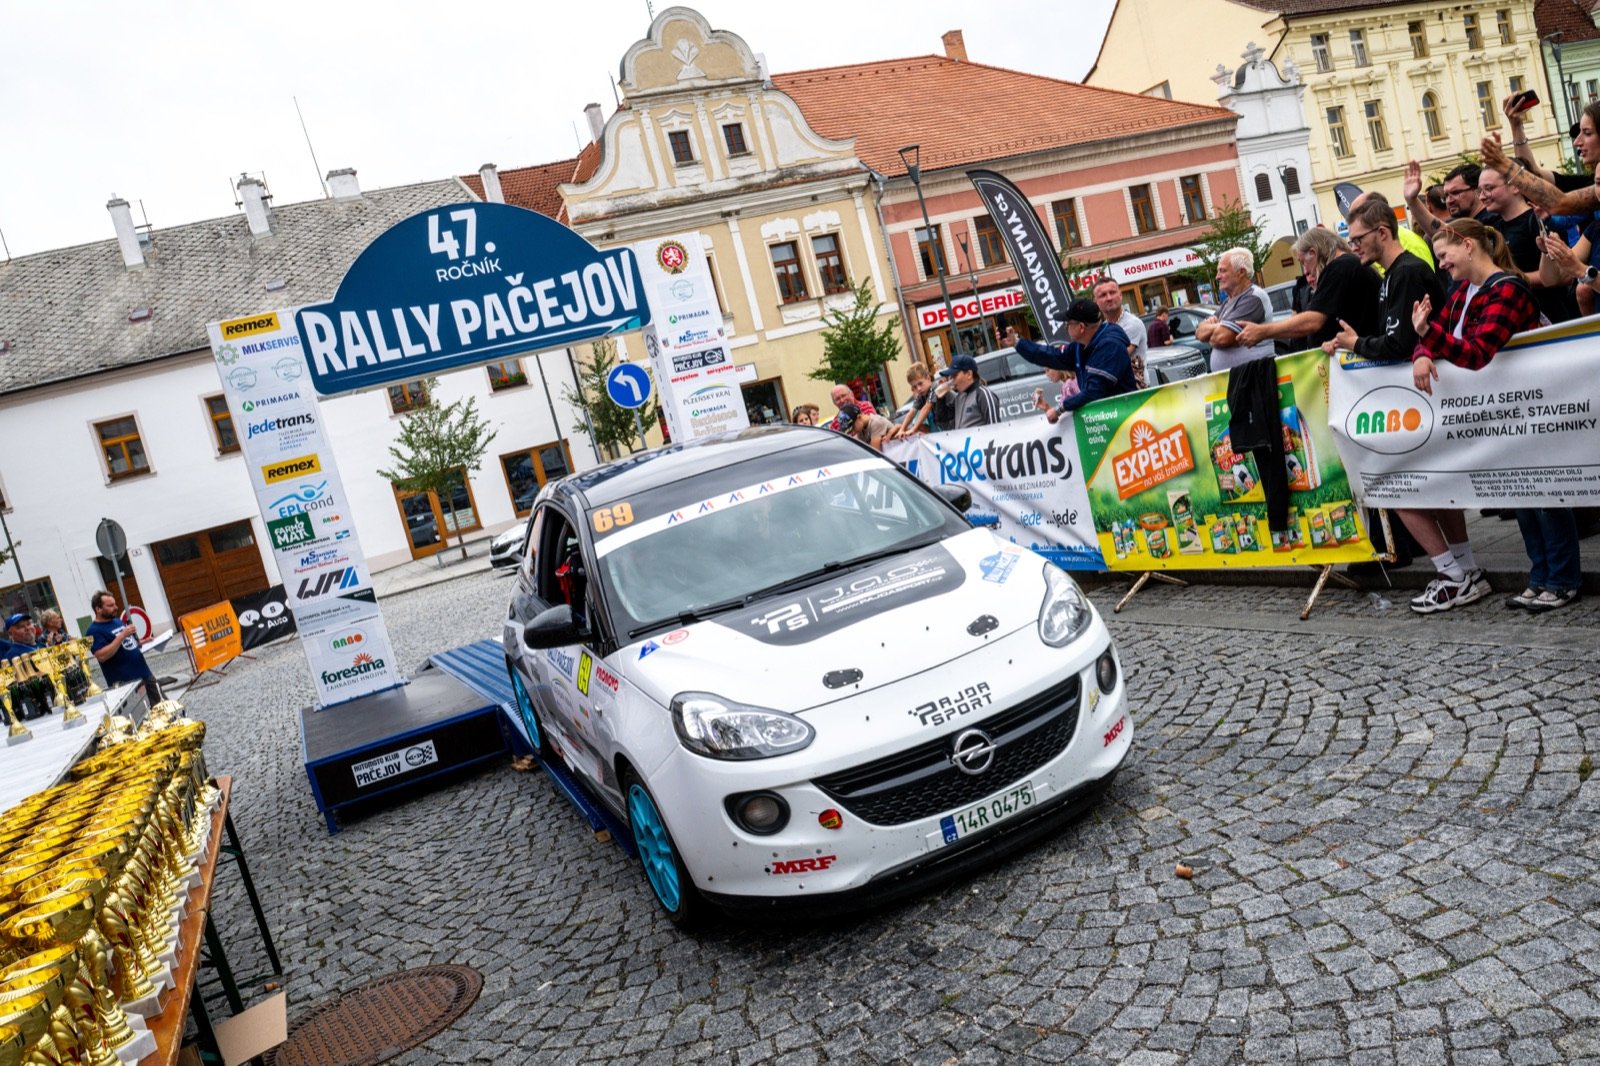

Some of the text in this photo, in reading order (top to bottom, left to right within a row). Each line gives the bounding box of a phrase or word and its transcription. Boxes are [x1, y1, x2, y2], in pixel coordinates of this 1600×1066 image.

[427, 208, 496, 261] 47.
[435, 257, 502, 283] ROČNÍK
[1124, 257, 1174, 277] KOSMETIKA
[302, 250, 638, 376] RALLY PAČEJOV
[242, 336, 301, 356] MILKSERVIS
[255, 392, 300, 408] PRIMAGRA
[1441, 388, 1544, 409] PRODEJ A SERVIS
[1081, 408, 1119, 423] Trávníková
[1355, 407, 1422, 435] ARBO
[1441, 398, 1591, 426] ZEMĚDĚLSKÉ, STAVEBNÍ
[1085, 423, 1111, 435] hnojiva,
[1088, 434, 1107, 445] osiva,
[1446, 418, 1598, 440] A KOMUNÁLNÍ TECHNIKY
[1115, 429, 1184, 487] EXPERT
[1143, 478, 1153, 487] na
[1165, 457, 1190, 476] trávník
[592, 502, 634, 534] 69
[205, 613, 230, 631] KLAUS
[332, 634, 363, 649] ARBO
[321, 658, 385, 685] forestina
[931, 693, 992, 727] SPORT
[353, 757, 384, 773] AUTOMOTO
[384, 752, 400, 764] KLUB
[356, 761, 400, 786] PAČEJOV
[957, 784, 1033, 834] 14R 0475
[946, 833, 958, 842] CZ
[771, 855, 837, 876] MRF
